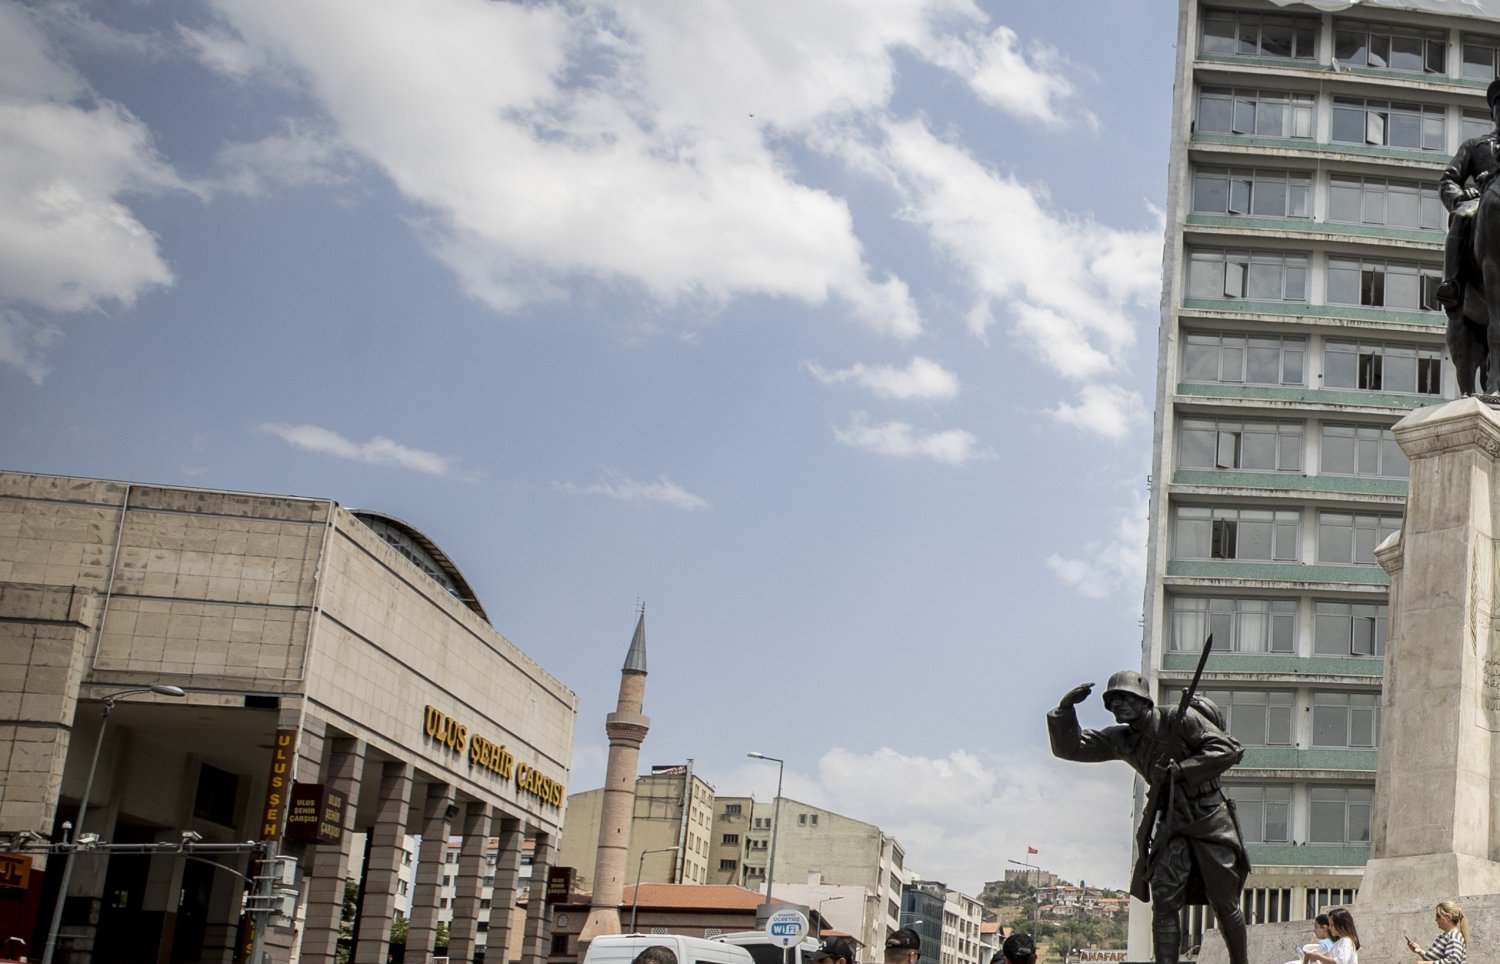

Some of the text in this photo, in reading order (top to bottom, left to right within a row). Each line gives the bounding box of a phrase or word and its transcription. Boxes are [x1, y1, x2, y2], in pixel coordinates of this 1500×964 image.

[425, 704, 566, 809] ULUS ŞEHİR ÇARŞISI
[294, 807, 316, 816] ŞEHİR
